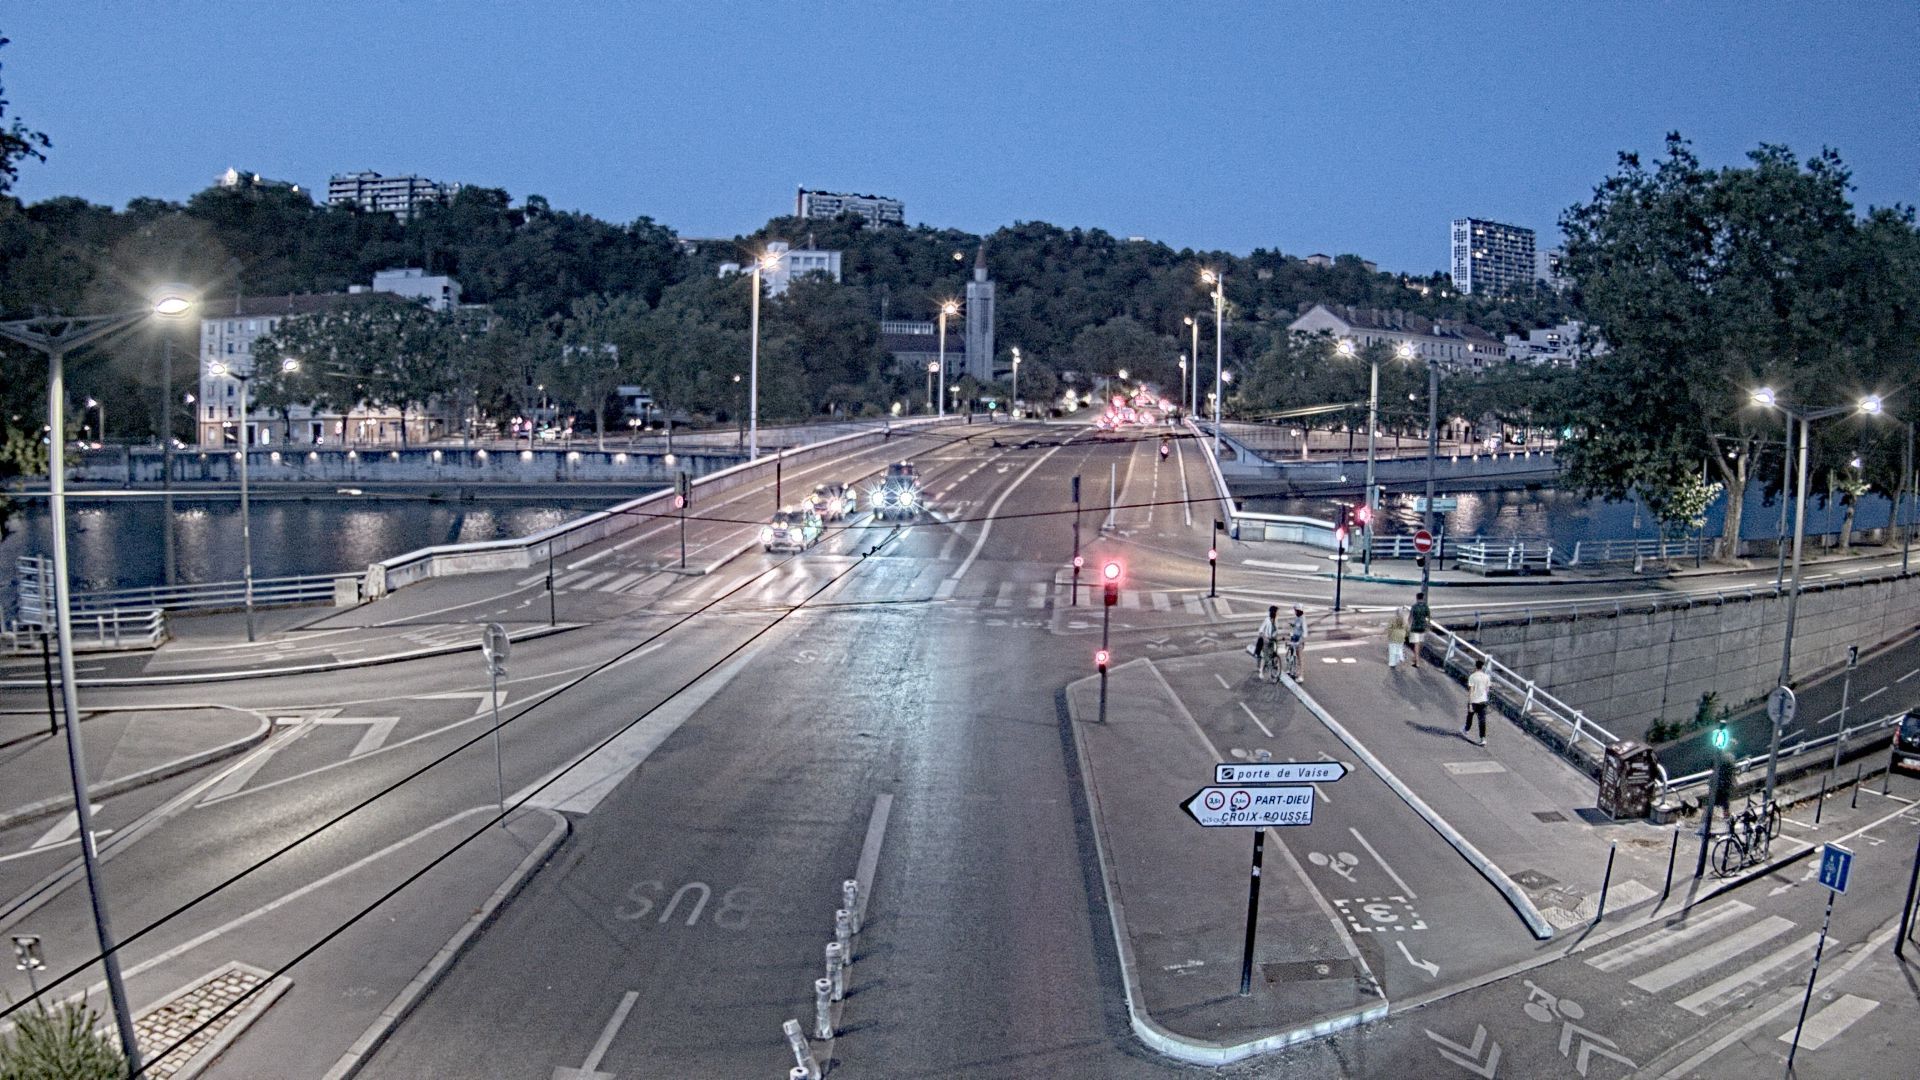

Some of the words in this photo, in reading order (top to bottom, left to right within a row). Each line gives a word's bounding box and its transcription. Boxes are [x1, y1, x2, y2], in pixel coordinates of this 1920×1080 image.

[1237, 768, 1270, 781] porte
[1277, 768, 1291, 778] de
[1298, 765, 1329, 778] Vaise
[1254, 795, 1311, 805] PART-DIEU
[614, 879, 760, 929] BUS
